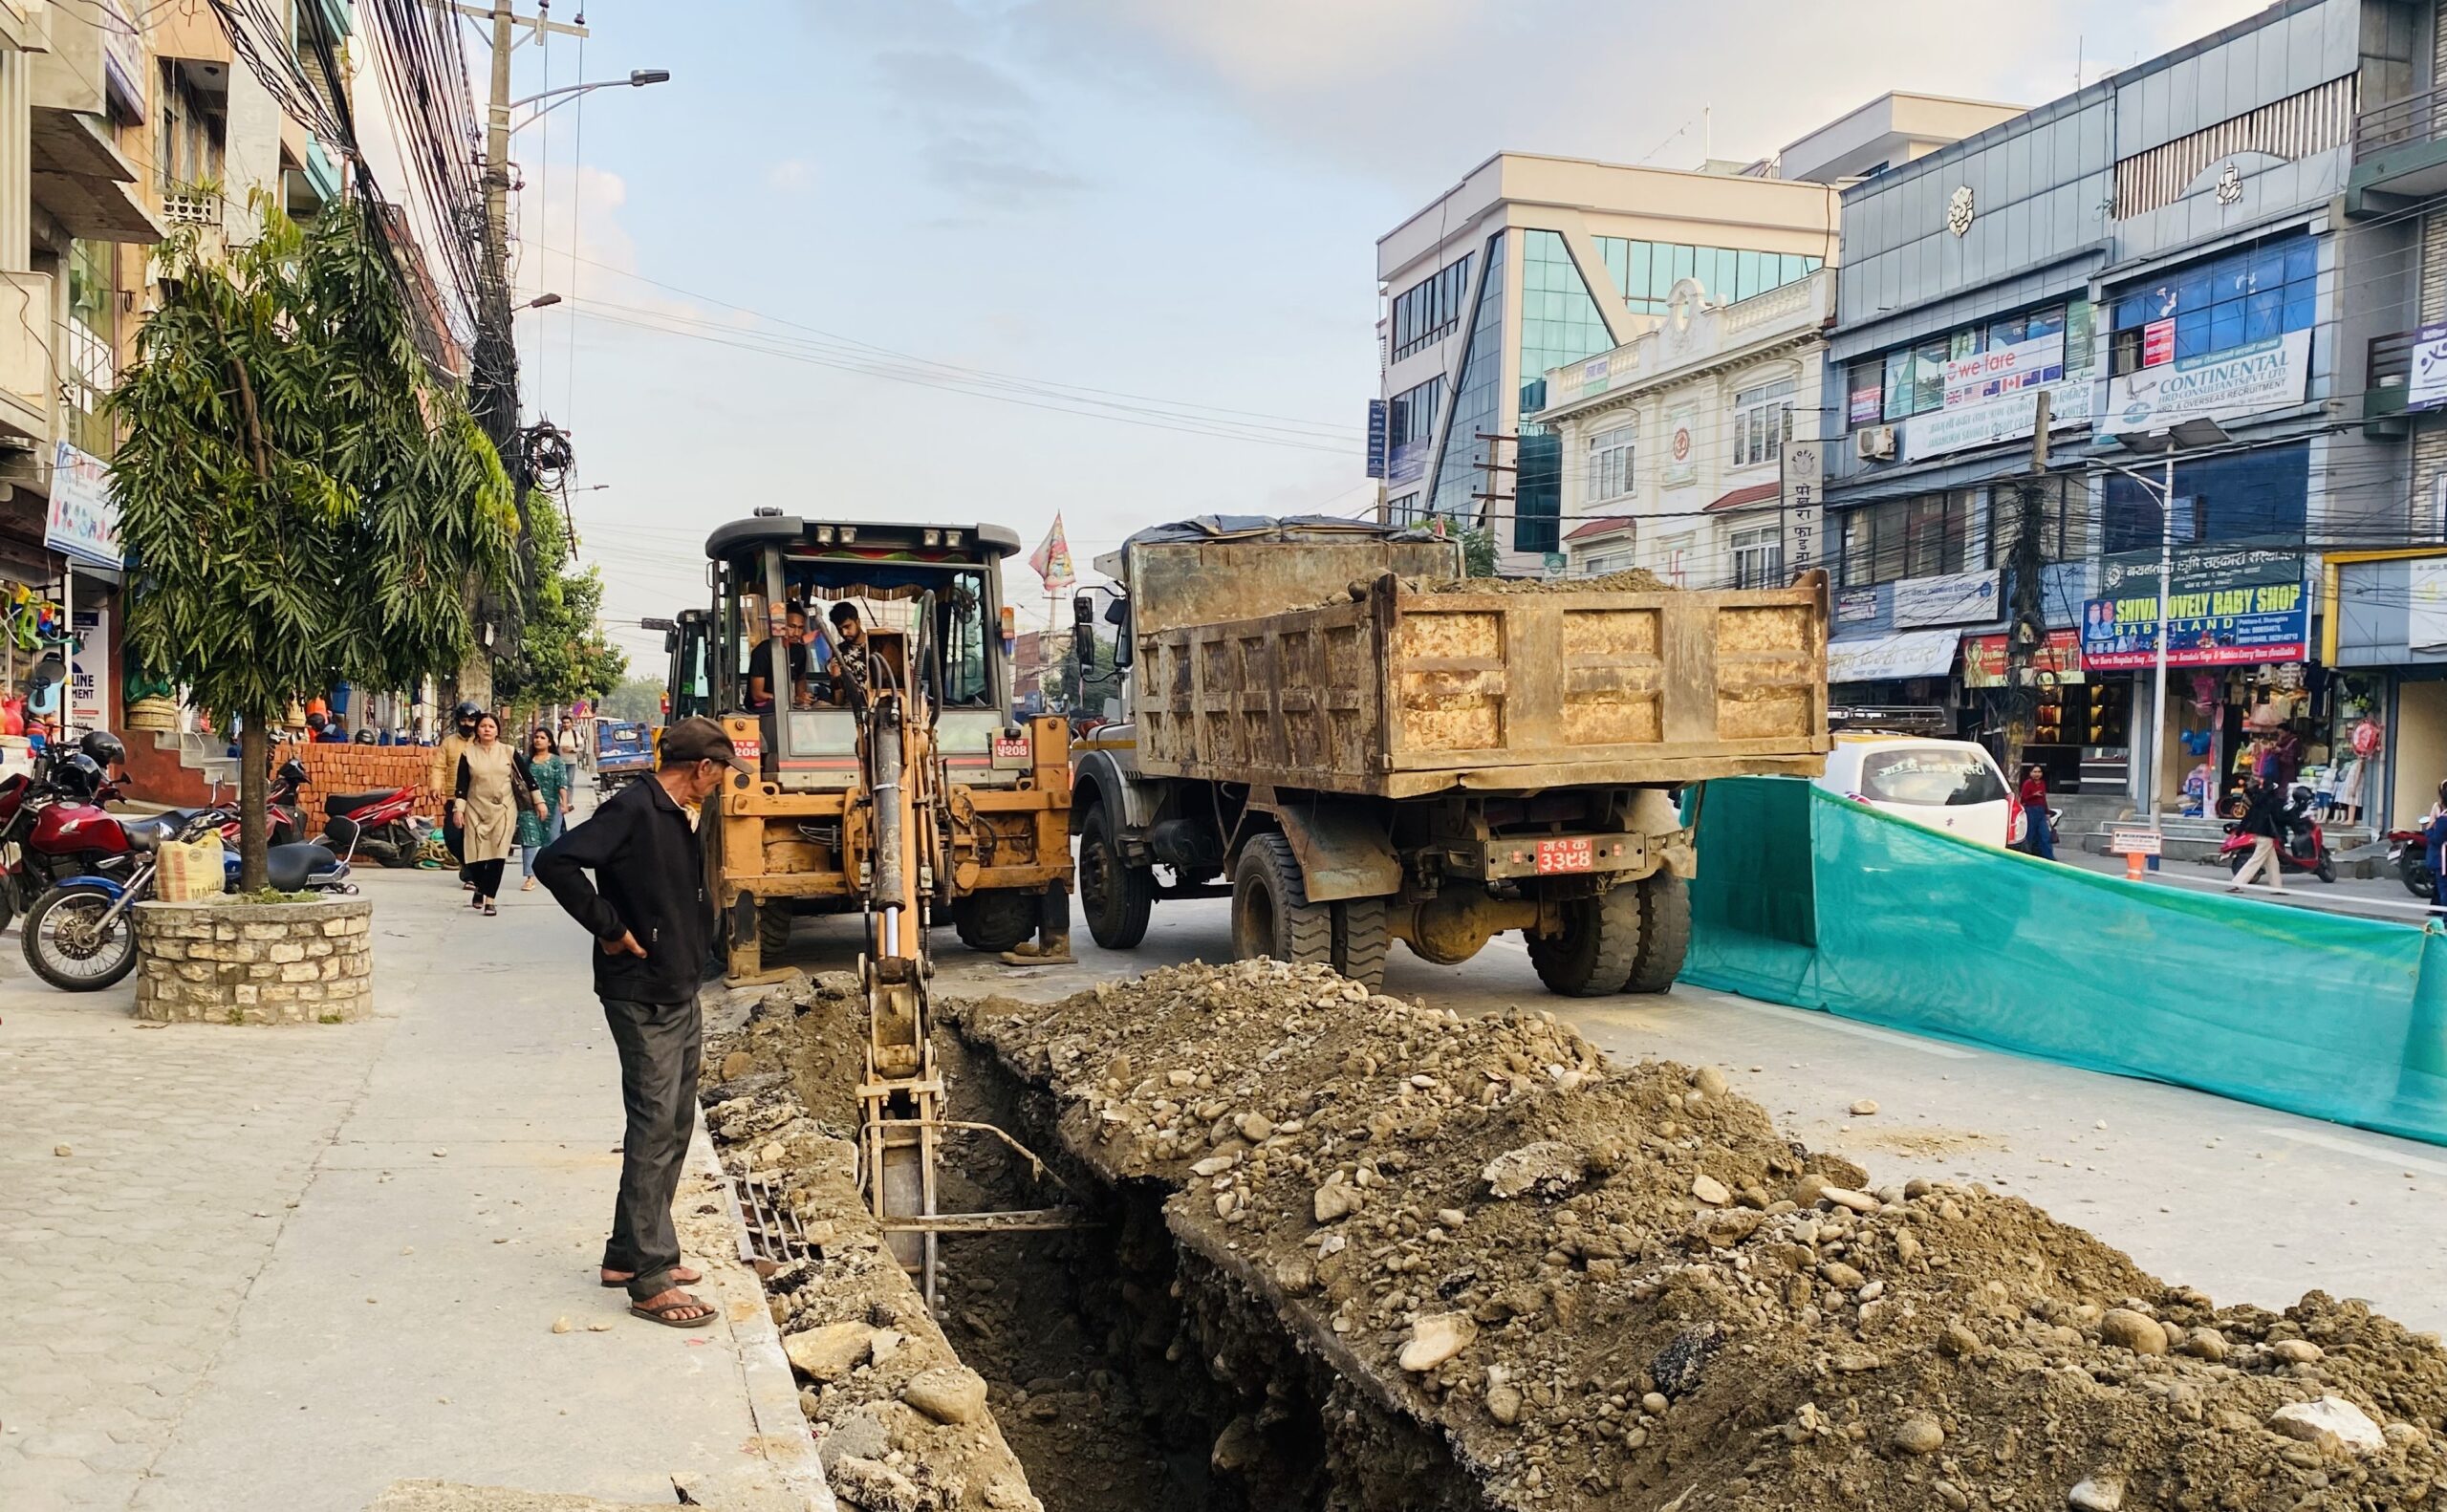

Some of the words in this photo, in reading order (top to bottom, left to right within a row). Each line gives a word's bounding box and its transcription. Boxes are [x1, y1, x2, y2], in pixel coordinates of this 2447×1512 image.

[1959, 361, 1981, 378] we
[2159, 351, 2289, 395] CONTINENTAL
[2158, 391, 2178, 405] HRD
[2184, 394, 2226, 408] OVERSEAS
[2227, 378, 2285, 399] RECRUITMENT
[2115, 597, 2158, 623] SHIVA
[2168, 592, 2210, 620] OVELY
[2213, 588, 2254, 616] BABY
[2257, 584, 2301, 614] SHOP
[72, 674, 95, 688] LINE
[72, 689, 95, 700] MENT
